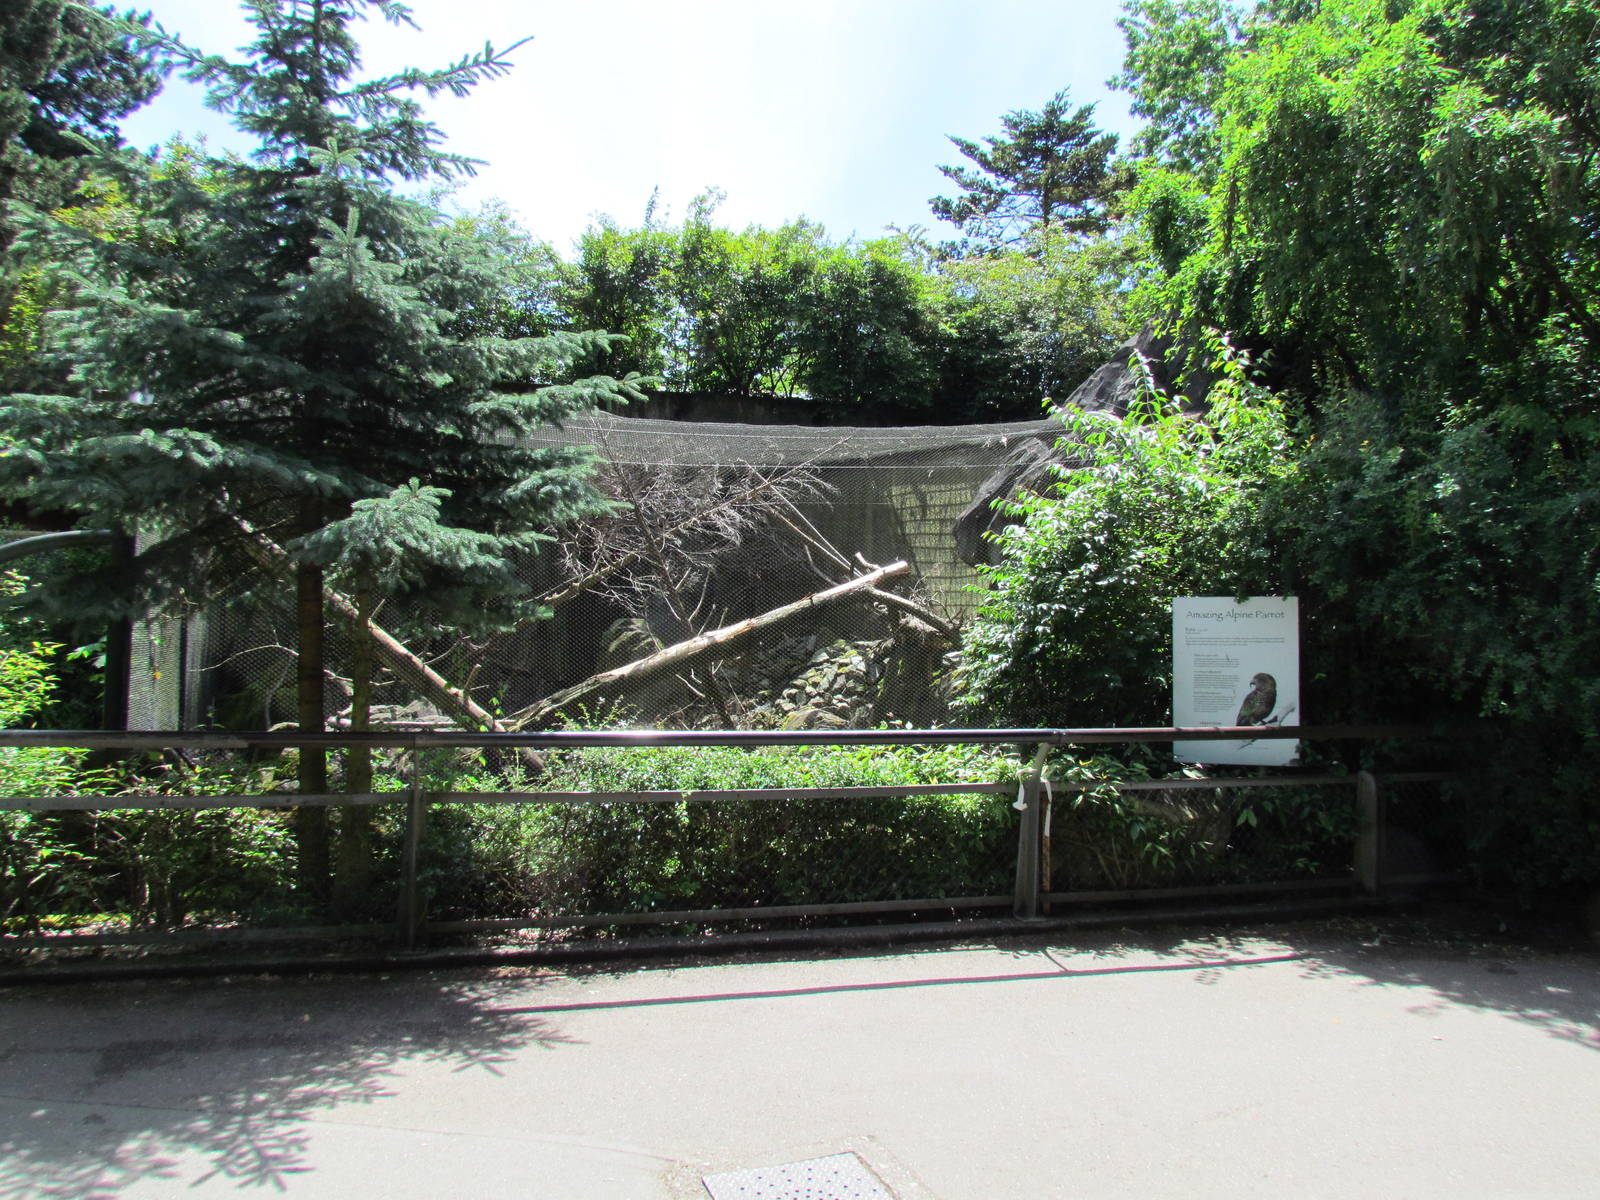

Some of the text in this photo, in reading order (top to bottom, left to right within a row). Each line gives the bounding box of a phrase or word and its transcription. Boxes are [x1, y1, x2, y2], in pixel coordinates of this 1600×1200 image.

[1186, 608, 1285, 622] Amazing Alpine Parrot
